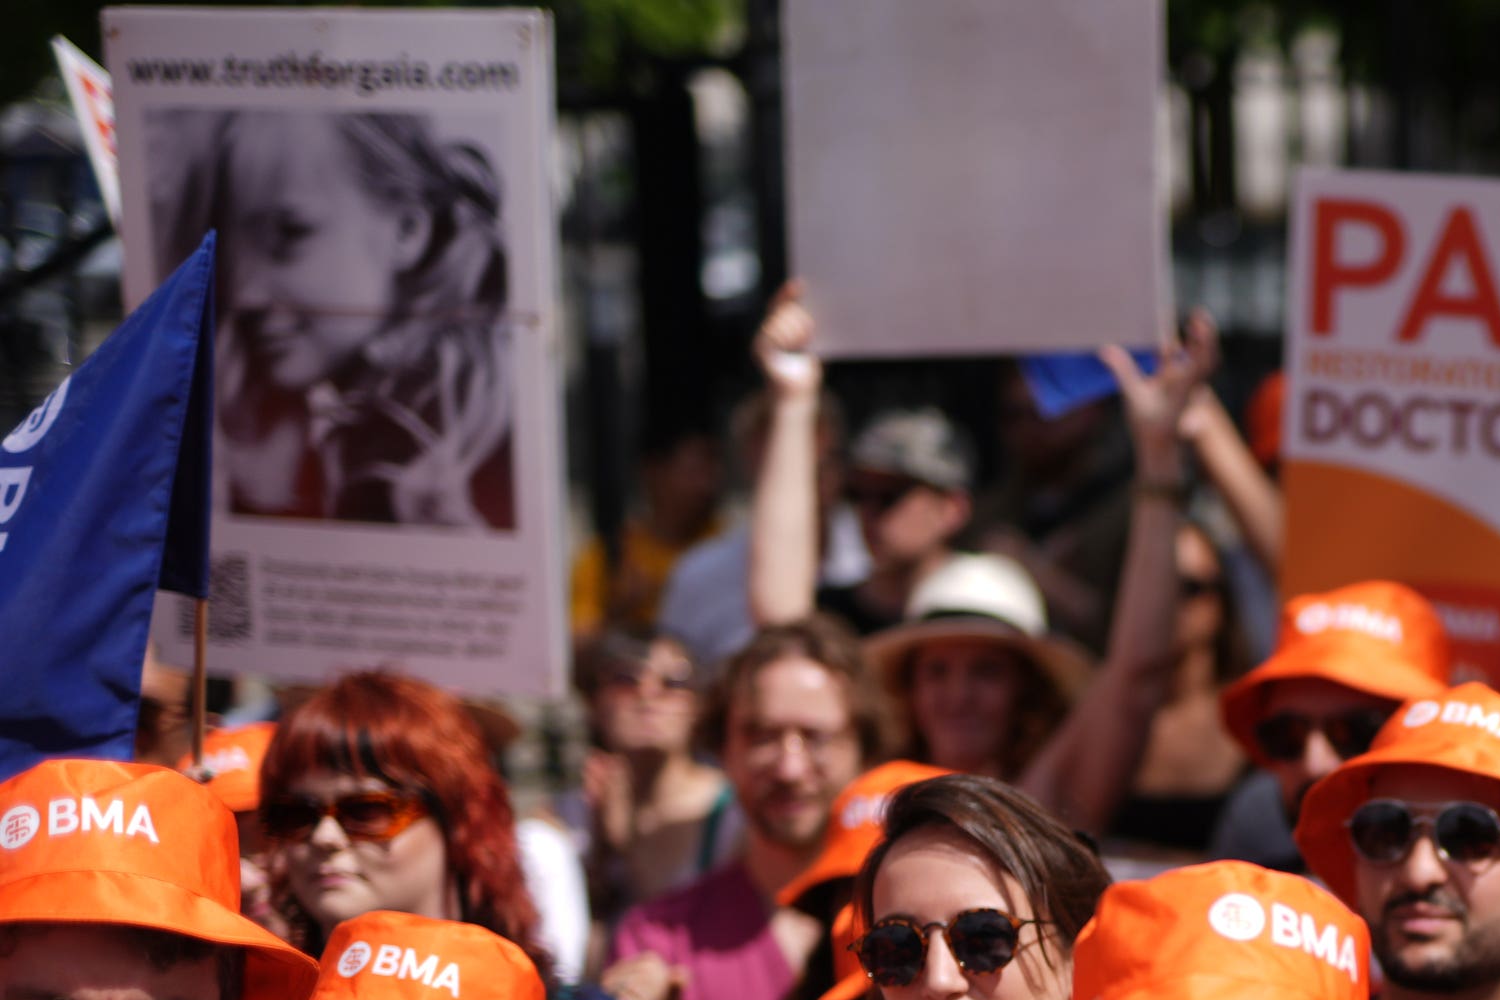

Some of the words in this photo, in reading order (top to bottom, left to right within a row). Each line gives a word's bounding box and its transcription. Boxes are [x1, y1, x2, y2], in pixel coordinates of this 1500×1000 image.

[128, 51, 519, 95] www.truthforgaia.com
[48, 797, 160, 844] BMA
[1271, 902, 1358, 984] BMA
[371, 944, 459, 998] BMA
